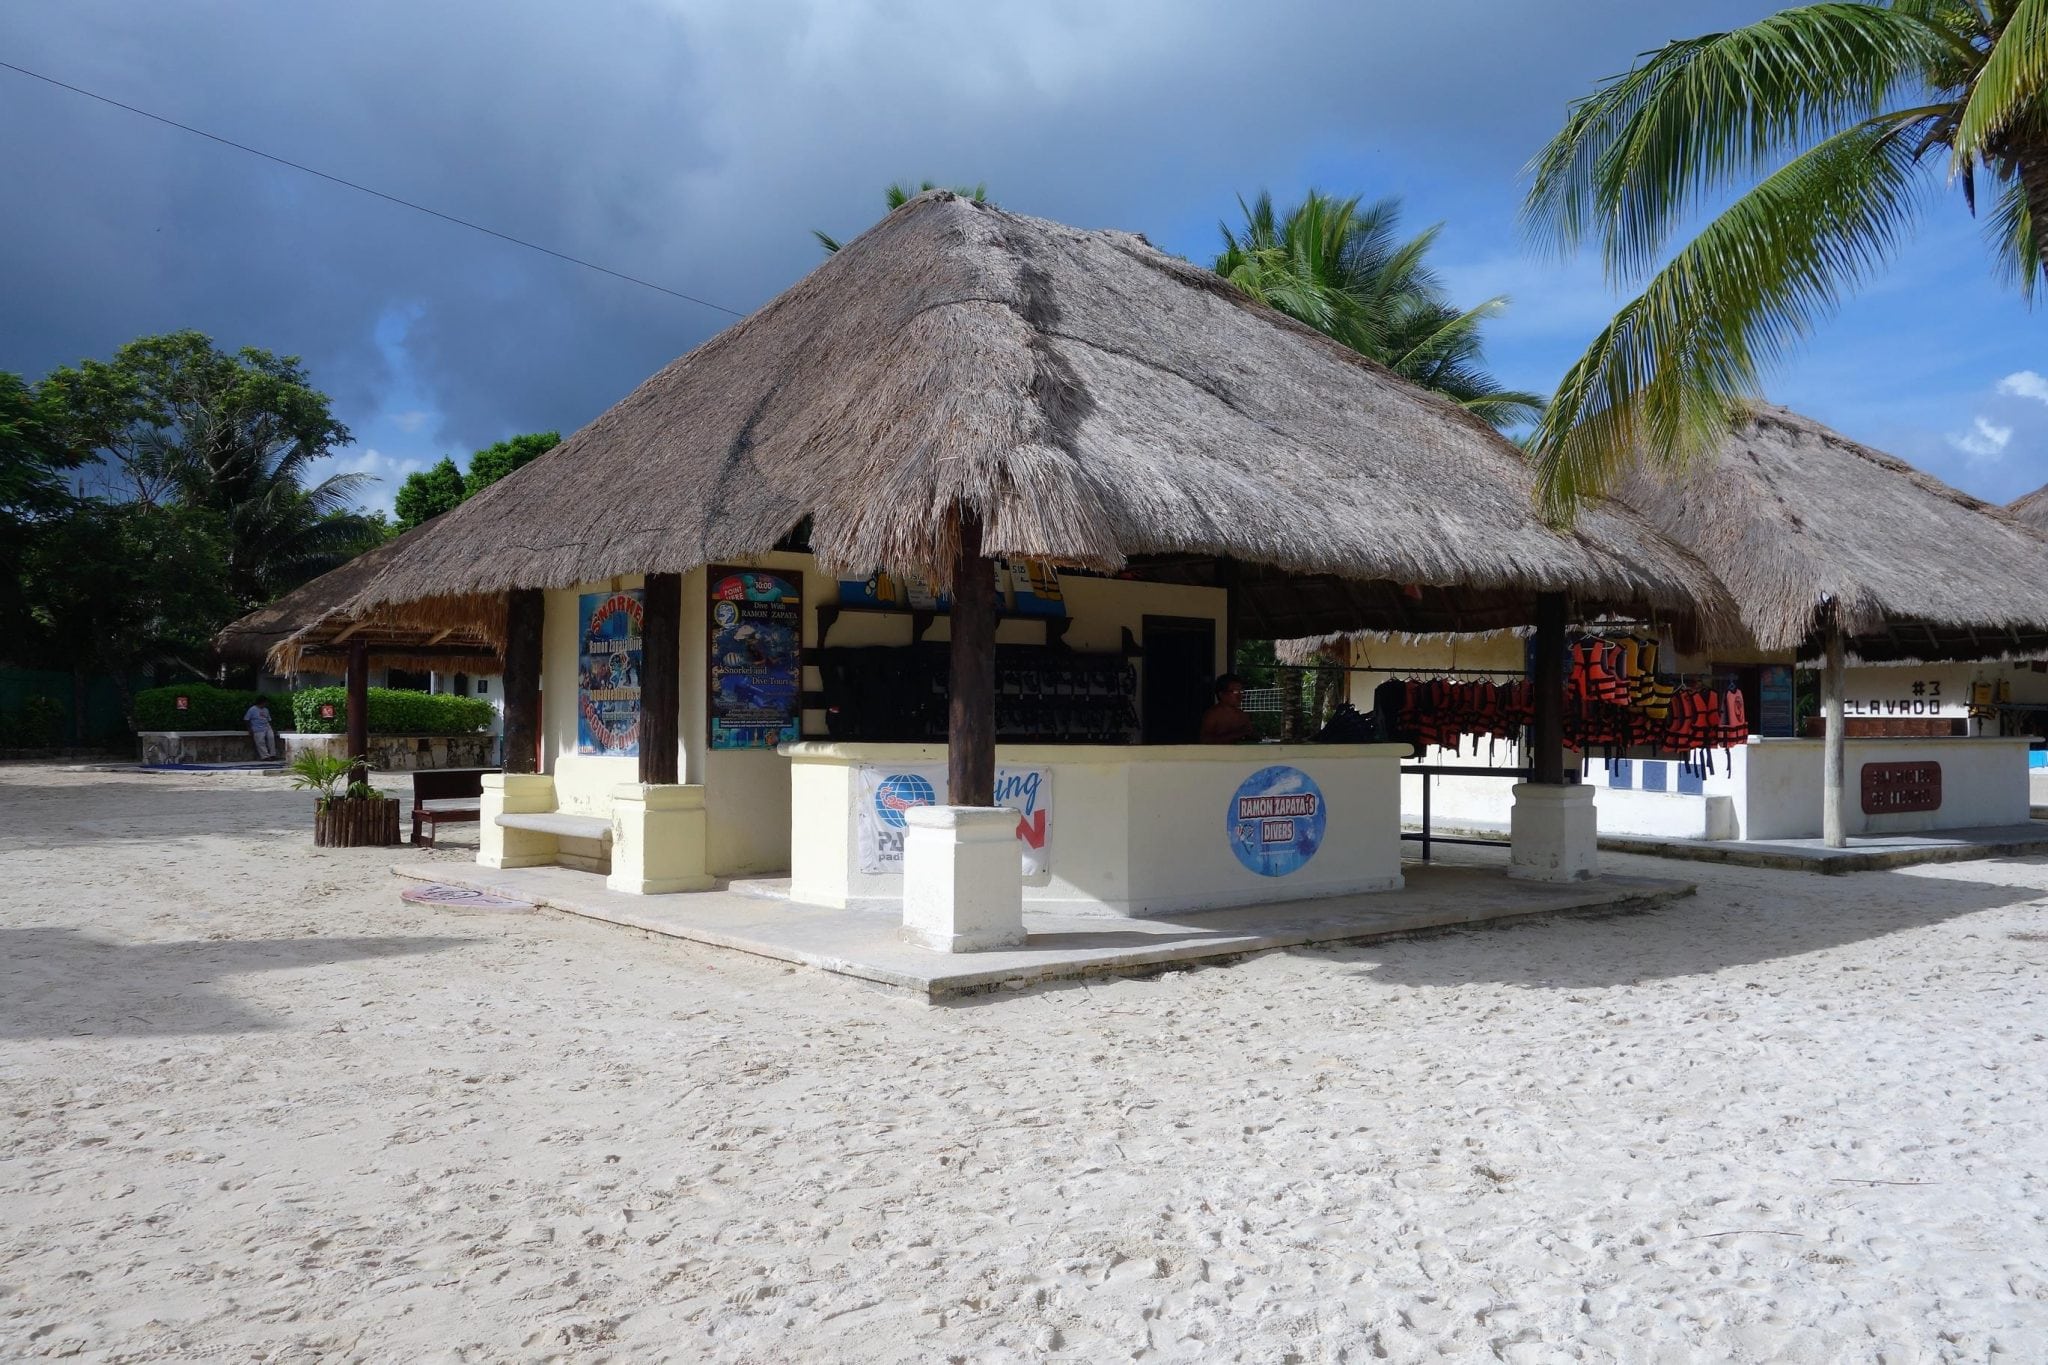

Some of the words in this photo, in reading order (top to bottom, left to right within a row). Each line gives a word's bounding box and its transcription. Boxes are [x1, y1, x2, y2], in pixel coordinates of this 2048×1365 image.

[771, 611, 798, 619] ZAPATA
[724, 666, 752, 675] Snorkel
[752, 677, 768, 685] Dive
[1912, 681, 1940, 696] #3
[993, 771, 1043, 815] ing
[1263, 822, 1293, 841] DIVERS
[878, 831, 905, 852] PA
[878, 852, 905, 862] padi
